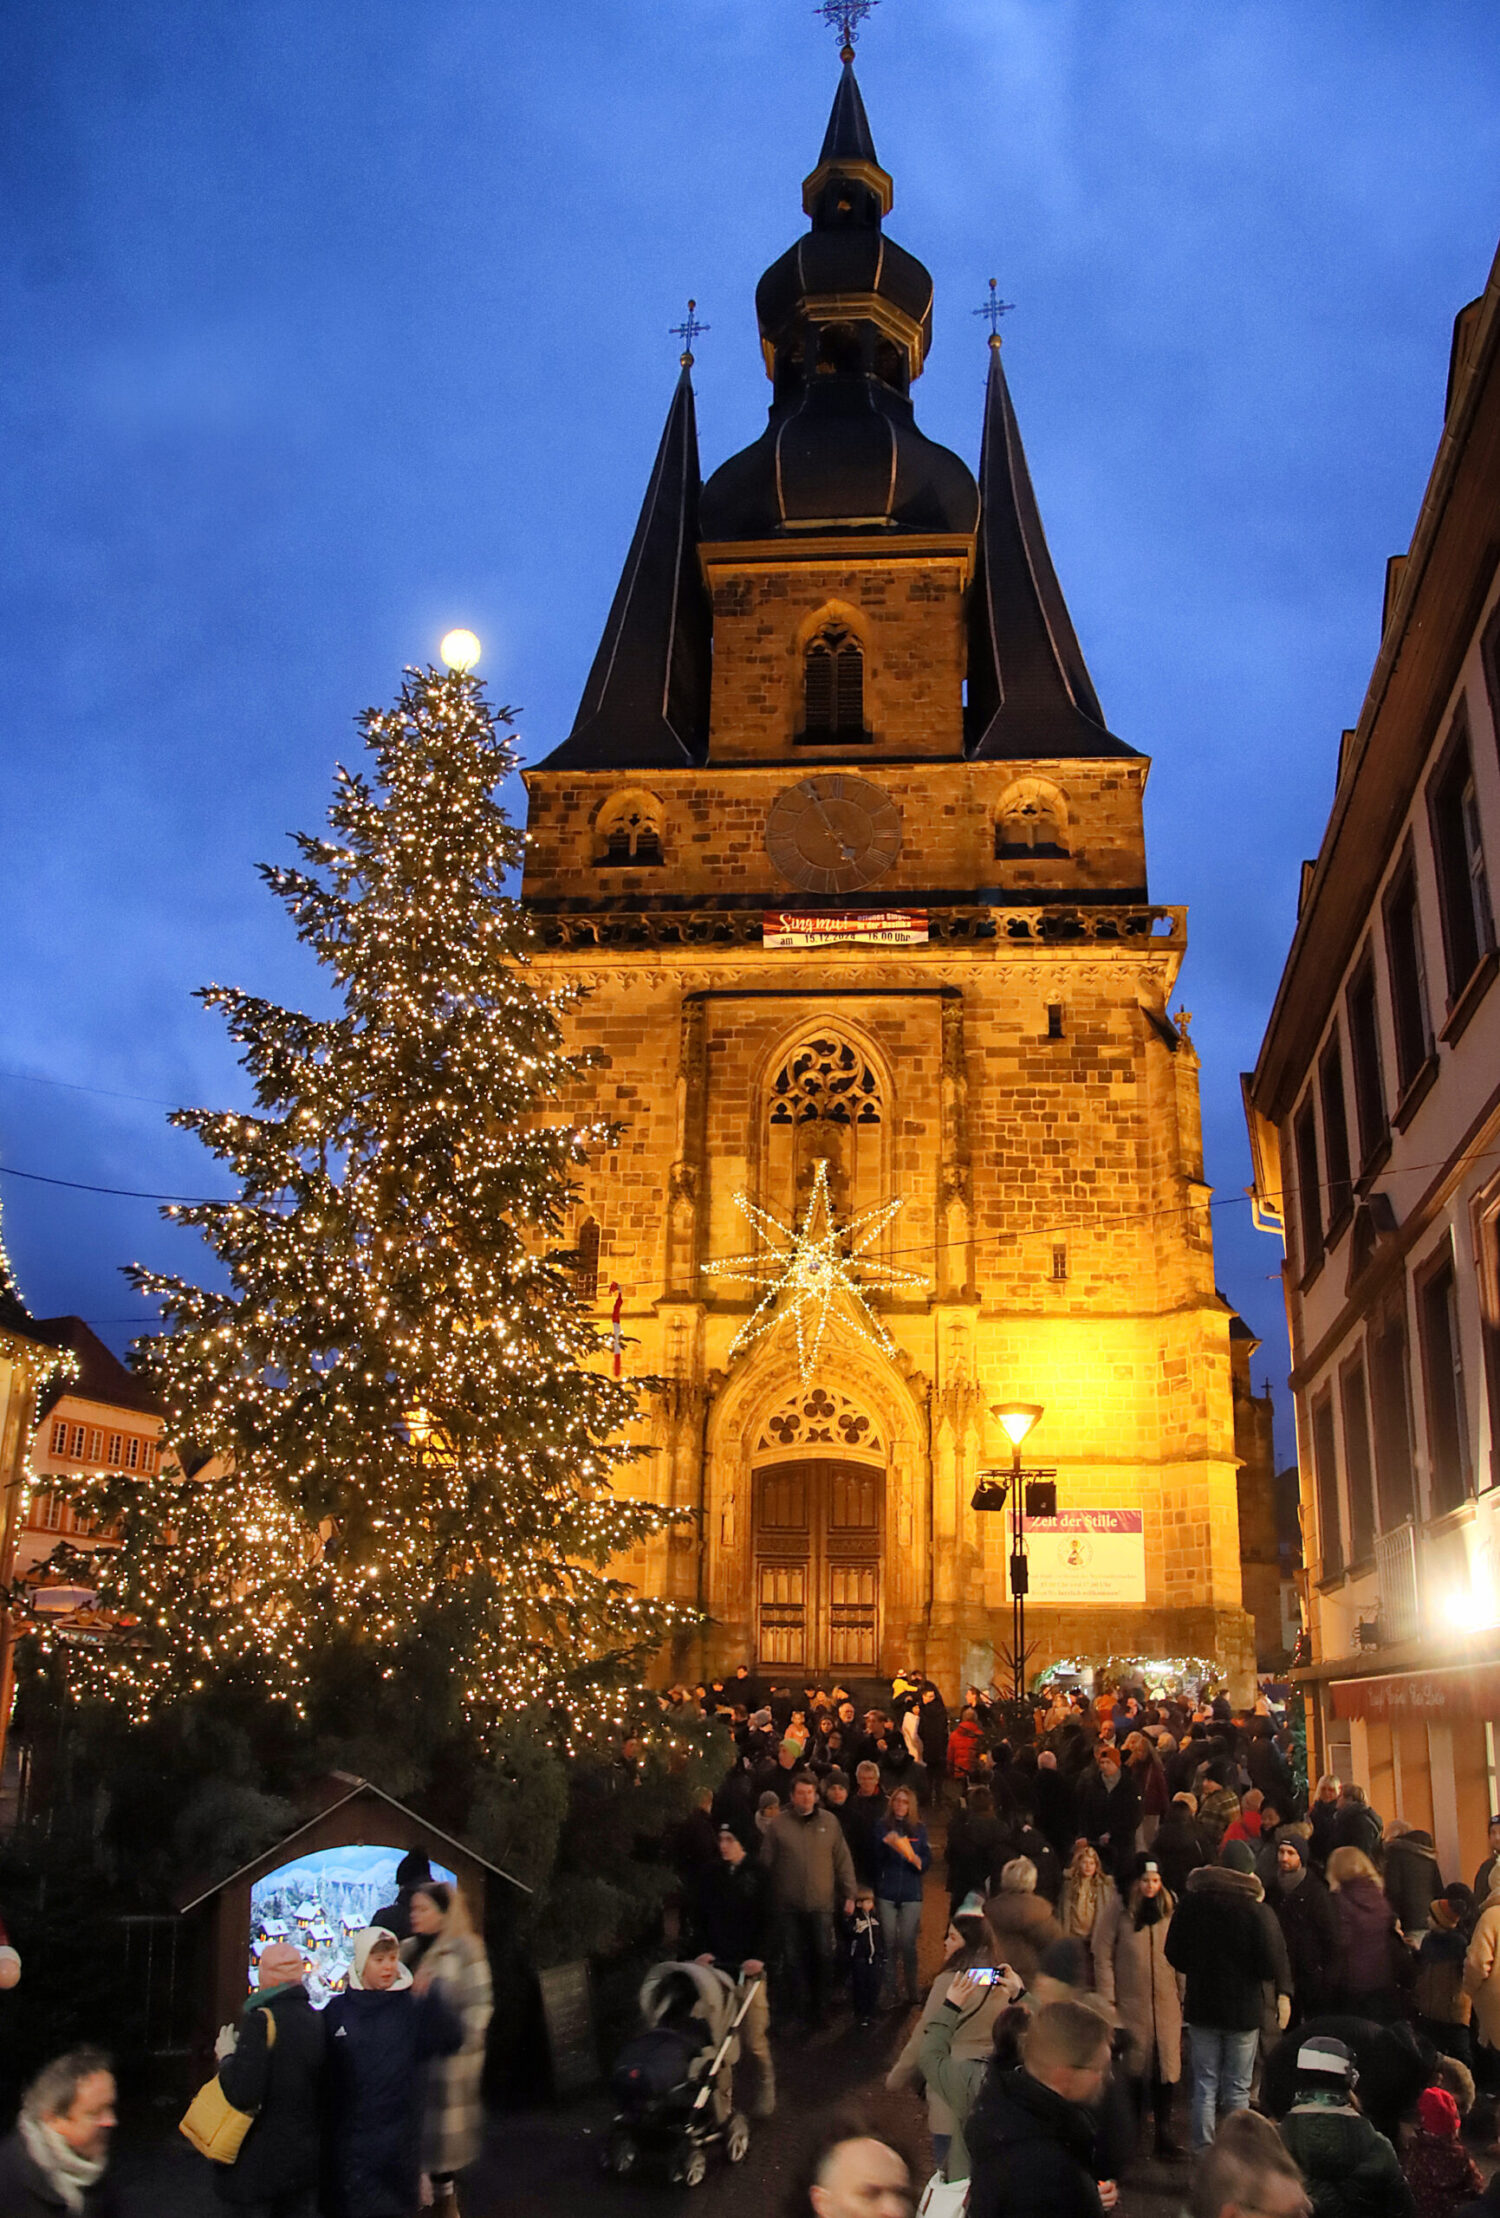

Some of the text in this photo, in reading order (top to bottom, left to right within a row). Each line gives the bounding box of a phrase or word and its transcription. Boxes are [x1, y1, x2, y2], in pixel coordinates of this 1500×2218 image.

[779, 912, 813, 933] Sing
[780, 937, 793, 945] am
[894, 932, 911, 942] Uhr
[1032, 1514, 1118, 1527] Zeit der Stille
